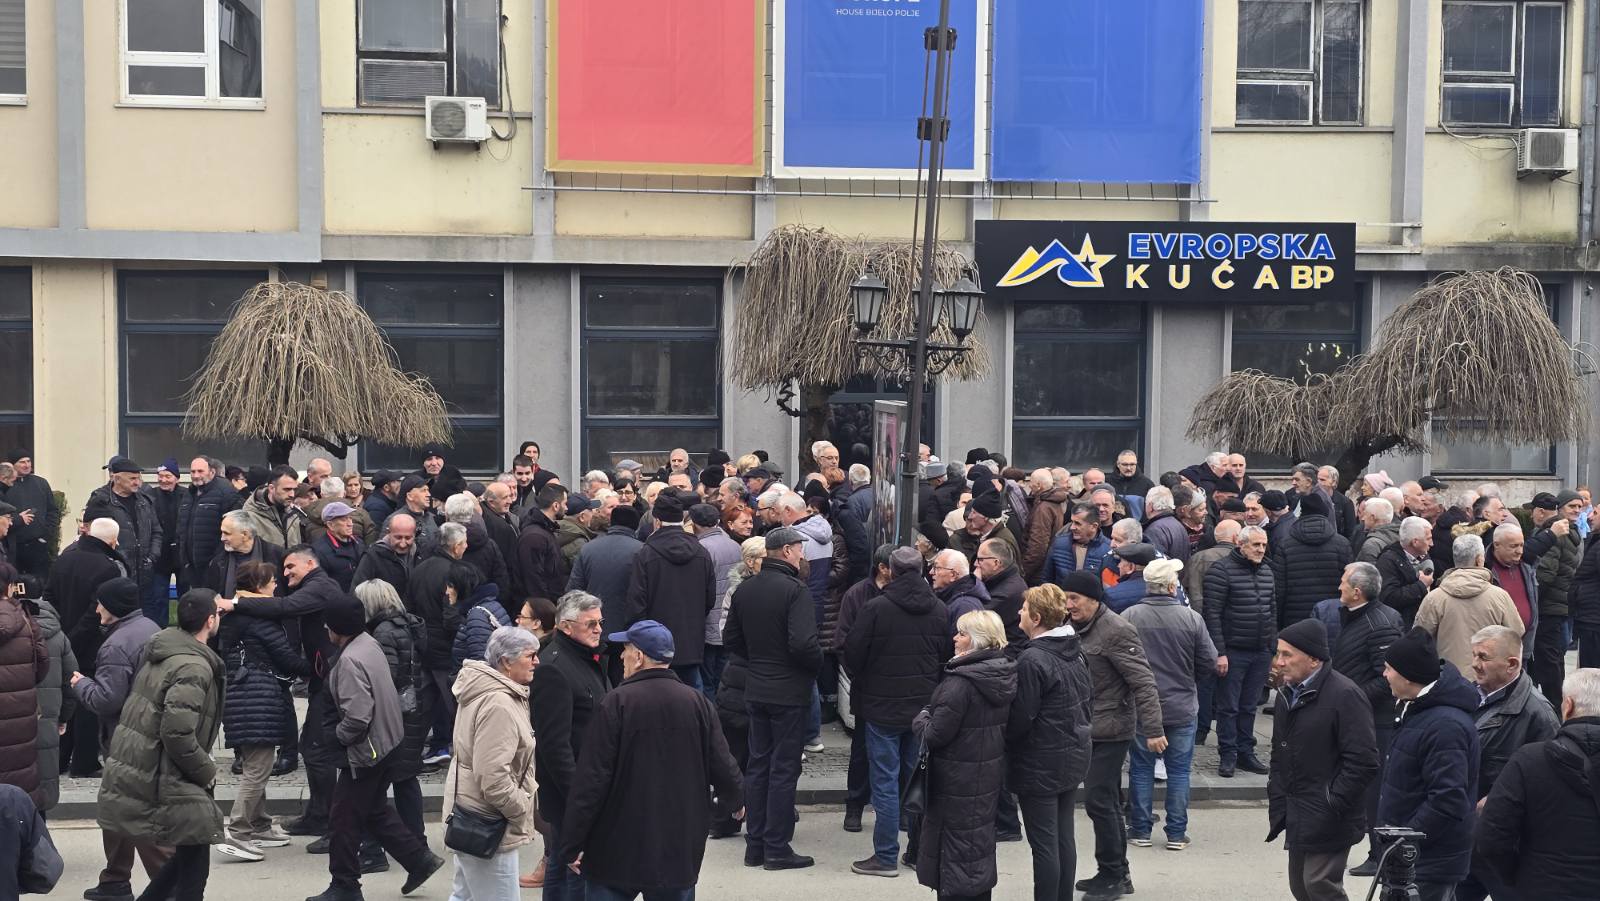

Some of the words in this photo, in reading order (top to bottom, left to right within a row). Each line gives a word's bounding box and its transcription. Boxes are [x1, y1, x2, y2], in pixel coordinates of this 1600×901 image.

[836, 8, 864, 16] HOUSE
[865, 8, 894, 17] BIJELO
[895, 9, 920, 17] POLJE
[1128, 232, 1336, 260] EVROPSKA
[1290, 265, 1335, 290] BP
